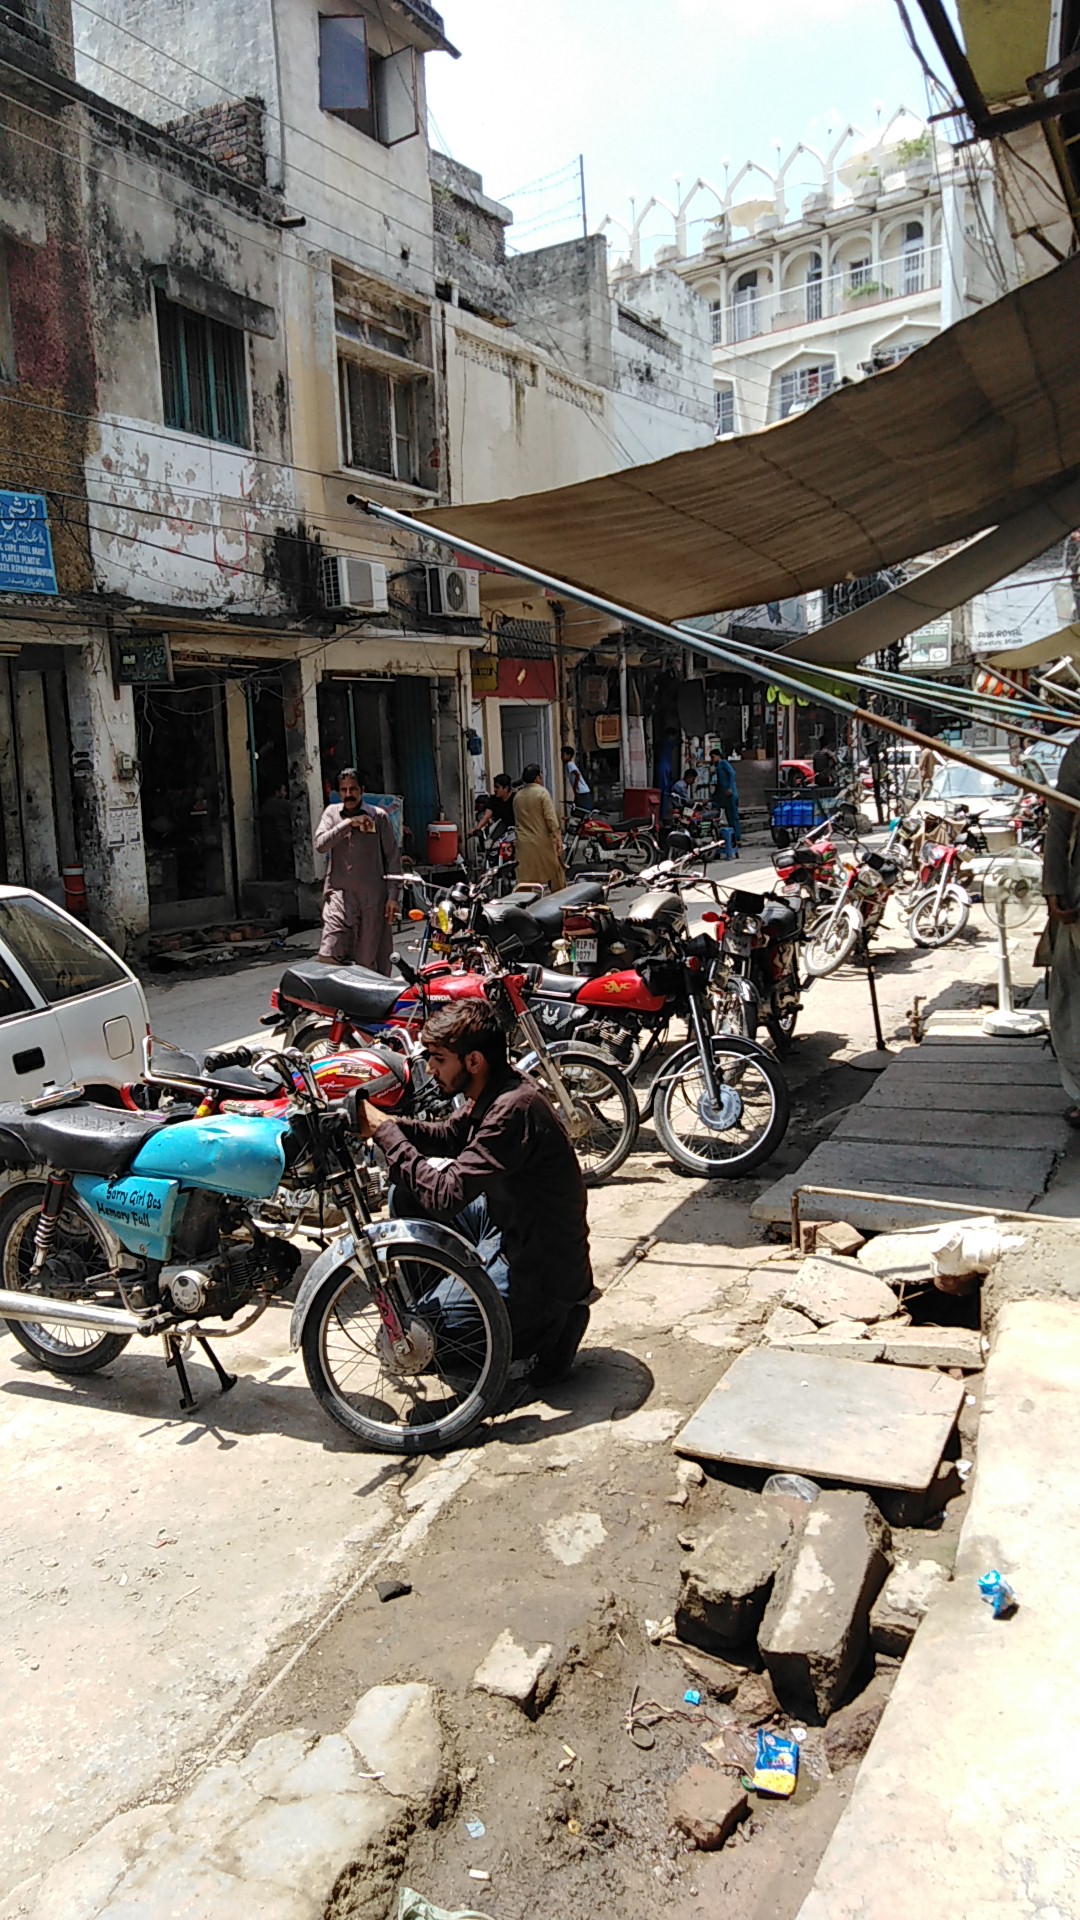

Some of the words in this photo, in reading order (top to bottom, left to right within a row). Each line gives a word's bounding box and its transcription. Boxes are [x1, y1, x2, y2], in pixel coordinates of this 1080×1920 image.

[106, 1187, 129, 1205] Sorry
[129, 1190, 147, 1206] Girl
[96, 1201, 130, 1224] Memory
[131, 1211, 150, 1227] Full
